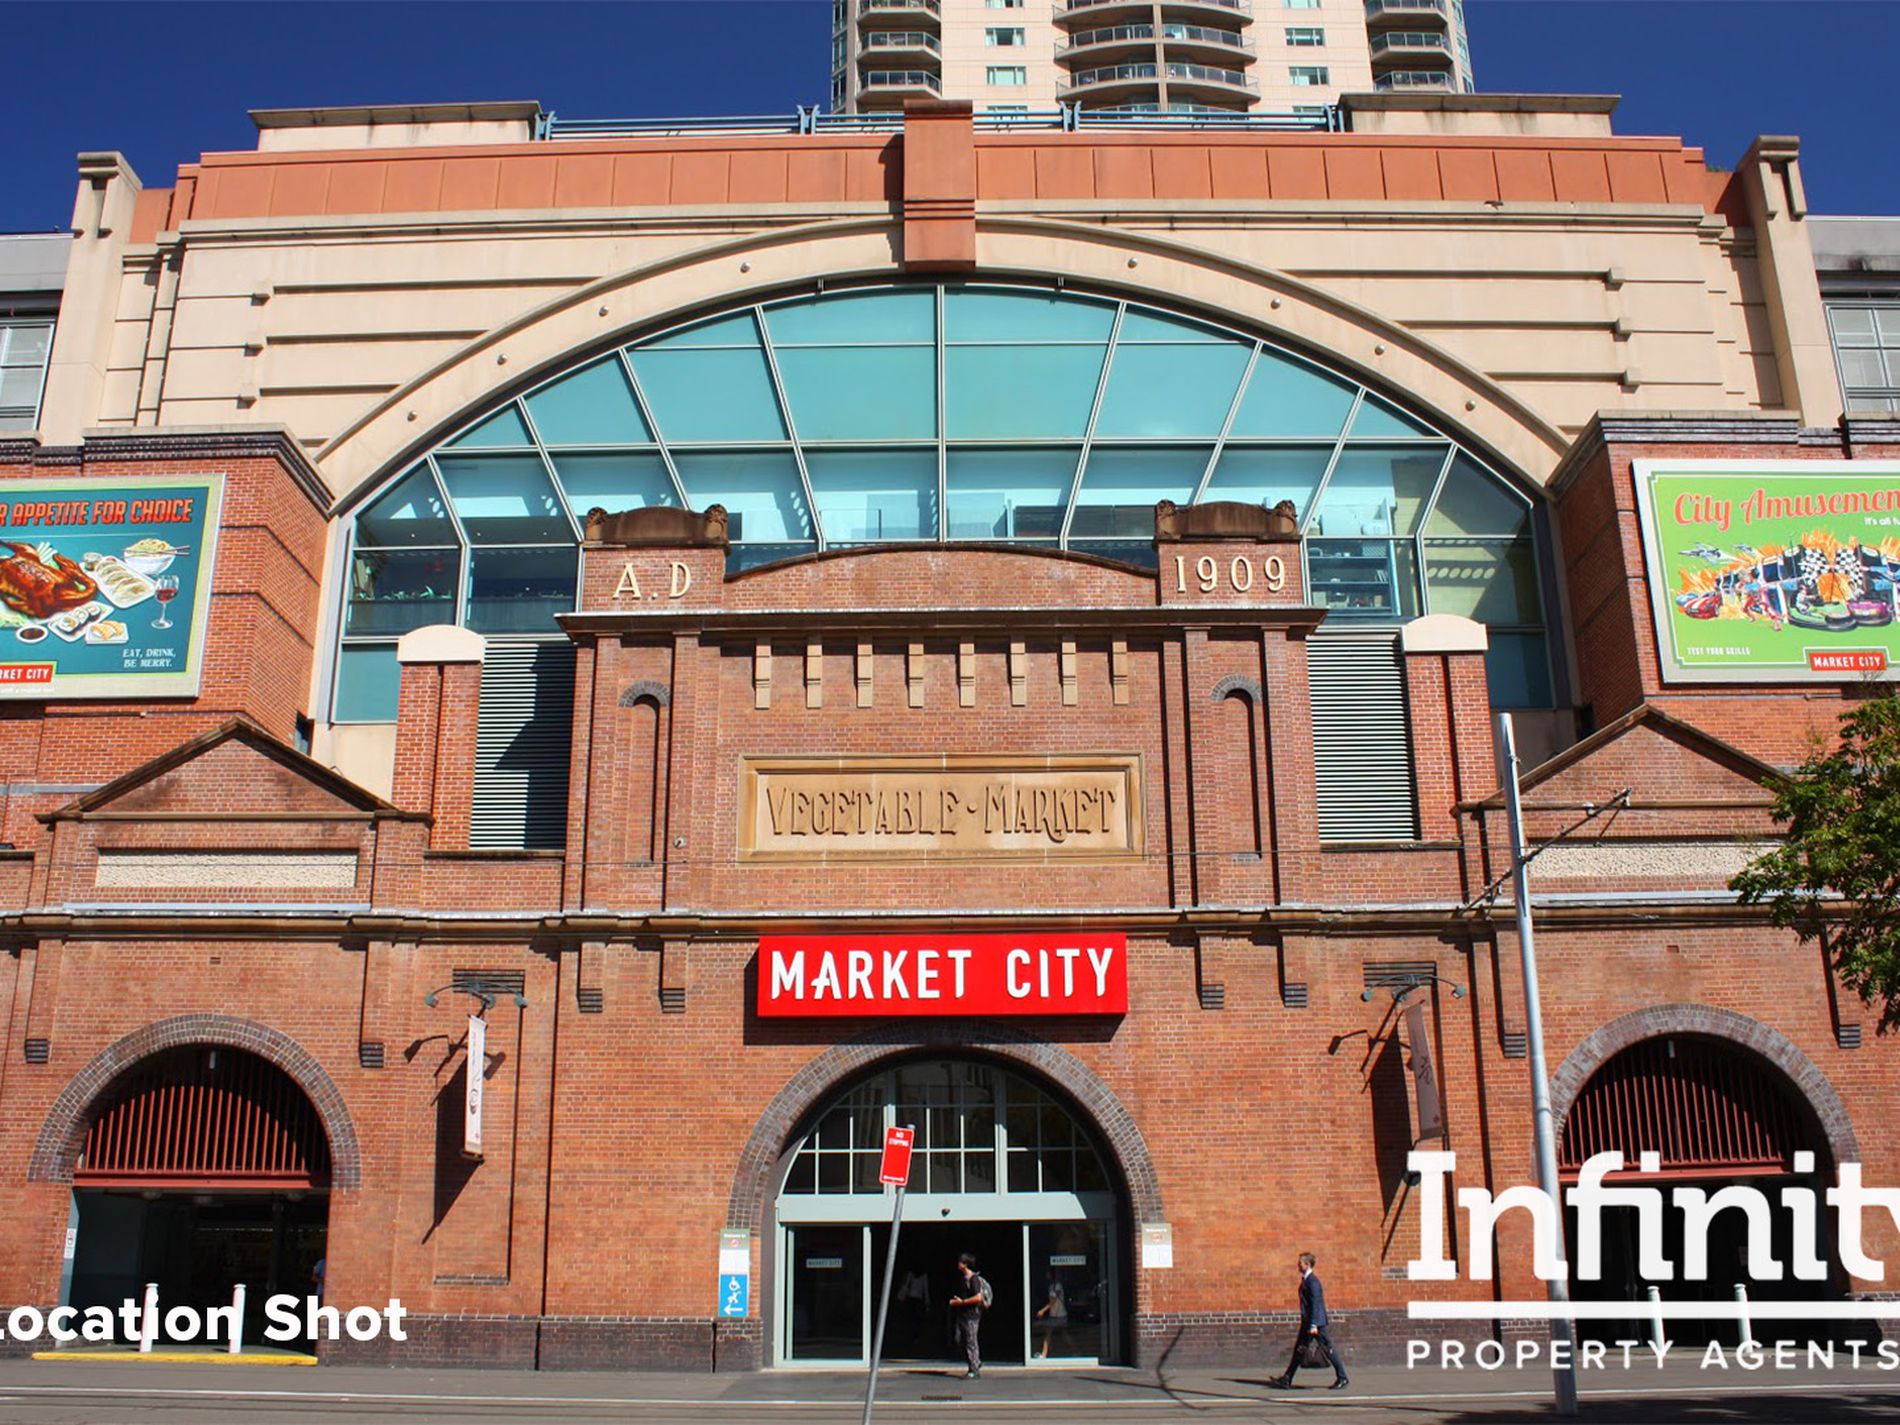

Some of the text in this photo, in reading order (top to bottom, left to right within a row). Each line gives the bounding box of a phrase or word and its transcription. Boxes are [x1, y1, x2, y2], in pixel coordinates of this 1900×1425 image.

[10, 502, 89, 526] APPETITE
[92, 501, 126, 524] FOR
[129, 498, 193, 524] CHOICE
[1675, 493, 1731, 532] City
[1176, 555, 1286, 594] 1909
[122, 647, 176, 659] EAT, DRINK,
[124, 658, 173, 668] BE MERRY.
[1813, 656, 1881, 667] MARKET CITY
[26, 667, 50, 679] CITY
[765, 785, 1115, 844] VEGETABLE MARKET
[770, 947, 1114, 1000] MARKET CITY
